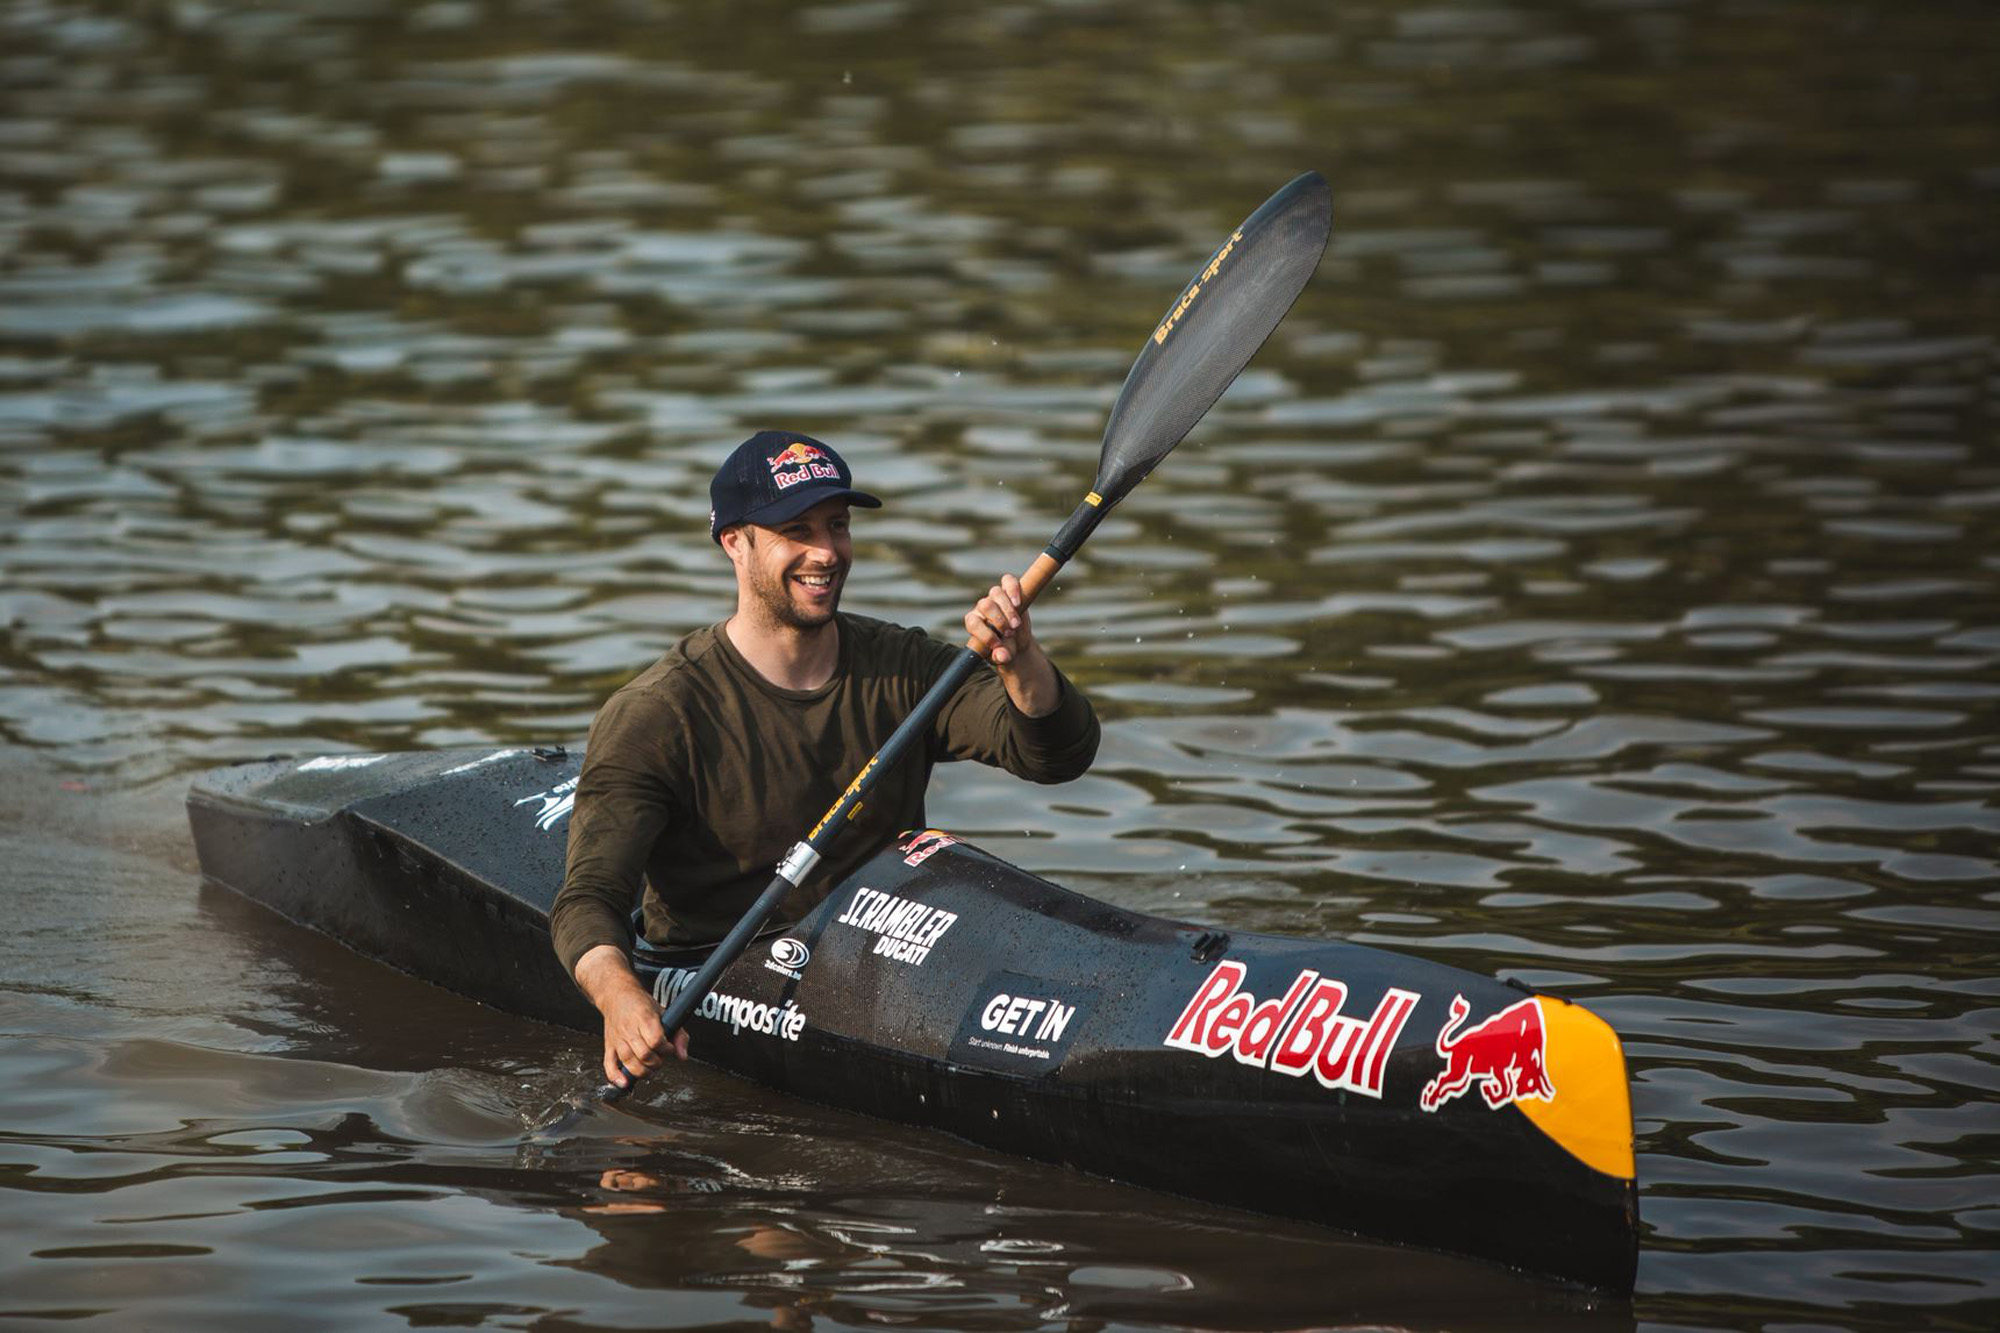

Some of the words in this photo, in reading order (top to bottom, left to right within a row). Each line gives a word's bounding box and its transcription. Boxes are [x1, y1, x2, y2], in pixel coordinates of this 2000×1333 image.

[774, 466, 810, 490] Red
[811, 463, 841, 480] Bull
[838, 887, 958, 948] SCRAMBLER
[872, 935, 931, 966] DUCATI
[694, 991, 806, 1041] omposite
[981, 994, 1047, 1036] GET
